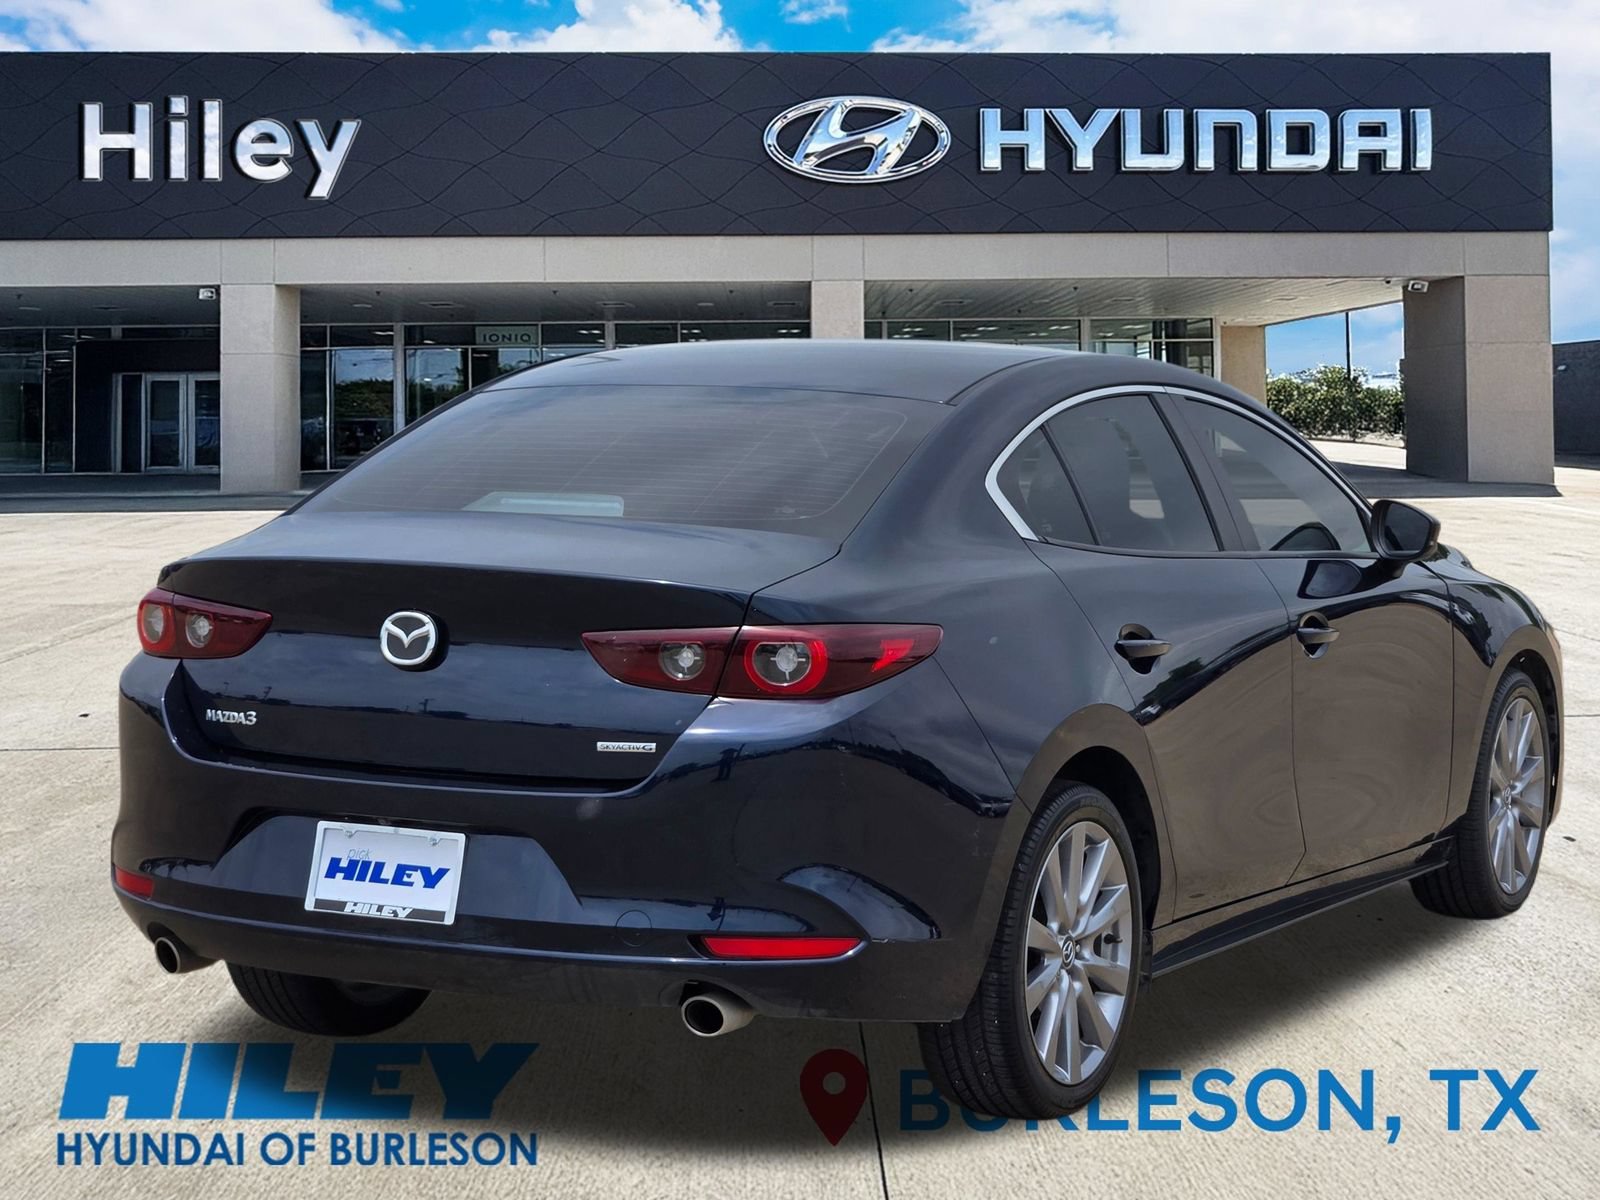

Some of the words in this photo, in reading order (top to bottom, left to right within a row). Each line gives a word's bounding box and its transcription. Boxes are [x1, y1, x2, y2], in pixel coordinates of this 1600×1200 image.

[79, 95, 362, 200] Hiley
[979, 107, 1432, 172] HYUNDAI
[205, 708, 257, 725] MAZDA3
[324, 856, 451, 889] HILEY
[344, 901, 413, 918] HILEY
